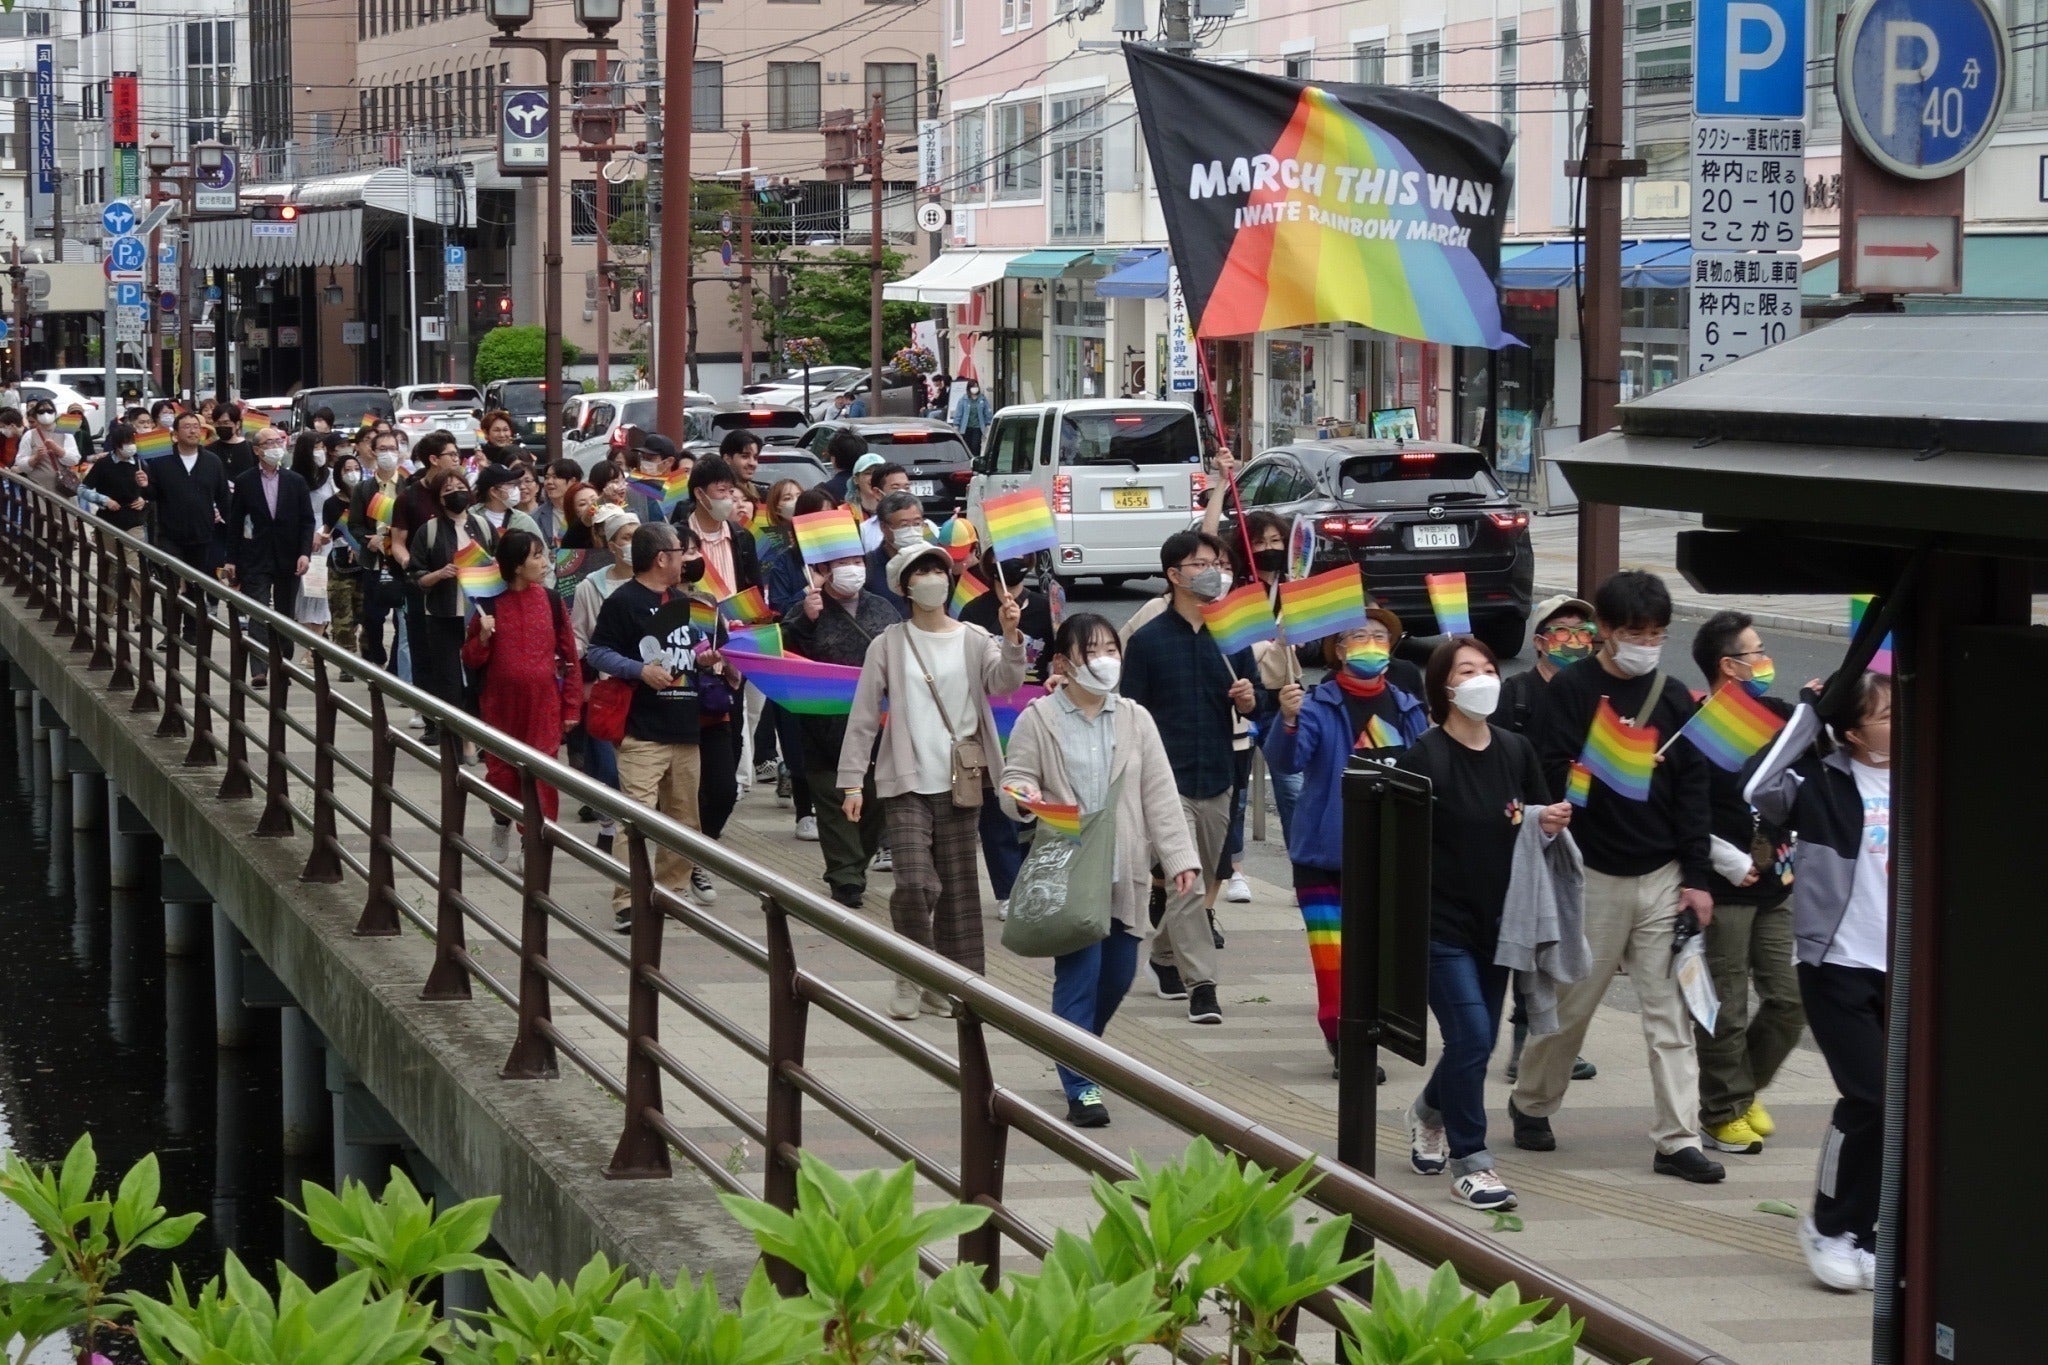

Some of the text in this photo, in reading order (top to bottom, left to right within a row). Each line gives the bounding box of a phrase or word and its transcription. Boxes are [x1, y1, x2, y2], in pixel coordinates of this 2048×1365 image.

[1725, 2, 1786, 103] P
[1882, 21, 1981, 139] P 40 分
[40, 70, 52, 183] SHIRASAKI
[1698, 127, 1802, 152] タクシー・運転代行車
[1189, 153, 1326, 200] MARCH
[1334, 166, 1420, 206] THIS
[1701, 160, 1796, 184] 枠内に限る
[1234, 201, 1472, 248] IWATE RAINBOW MARCH
[1701, 220, 1794, 242] ここから
[119, 245, 132, 265] P
[127, 256, 138, 266] 40
[451, 248, 461, 263] P
[1696, 259, 1798, 284] 貨物の積卸し車両
[123, 285, 136, 303] P
[1698, 292, 1793, 316] 枠内に限る
[1122, 496, 1148, 507] 45-54
[1425, 533, 1457, 545] 10-10
